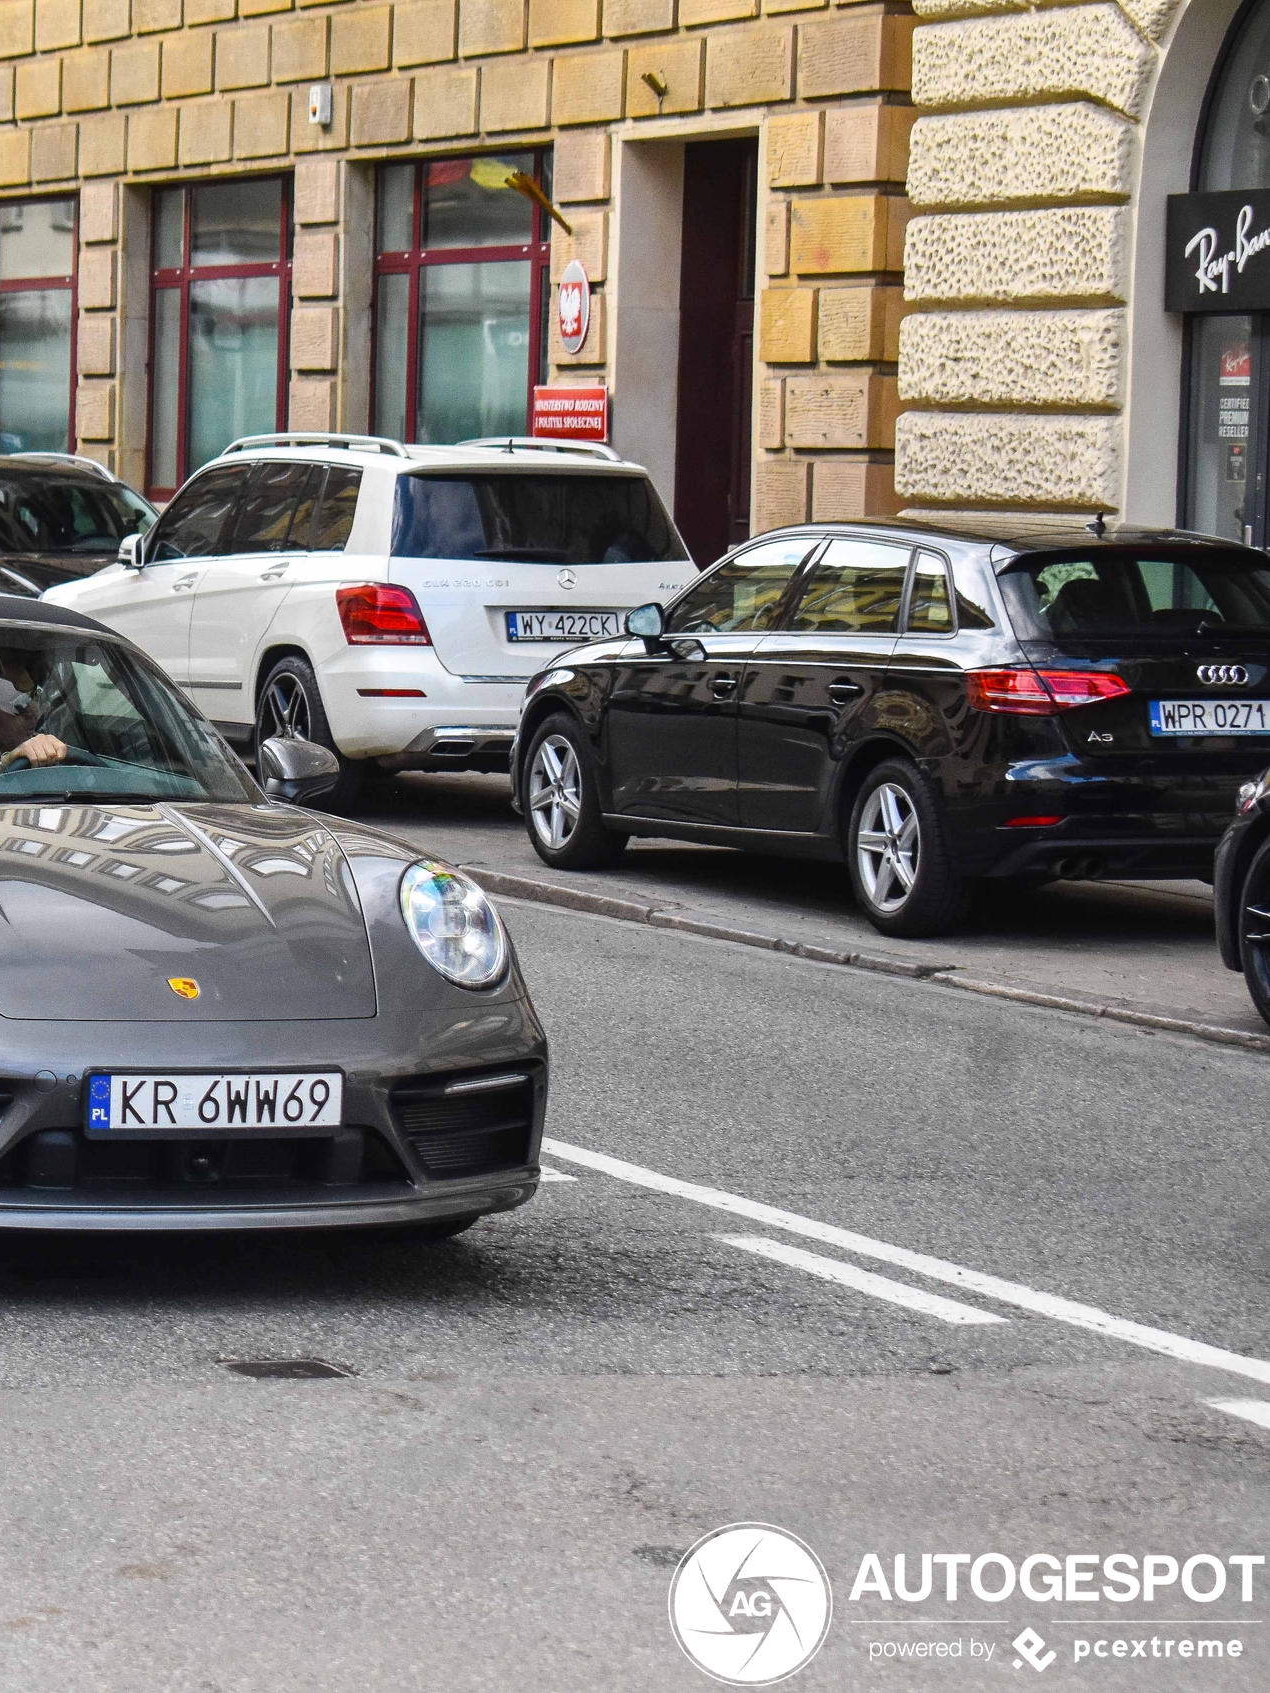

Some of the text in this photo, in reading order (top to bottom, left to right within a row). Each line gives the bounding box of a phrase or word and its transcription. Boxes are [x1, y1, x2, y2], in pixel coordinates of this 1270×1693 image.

[575, 399, 605, 412] RODZINY
[423, 579, 510, 588] GLK 220 CDI
[521, 615, 612, 636] WY 422CK
[1162, 704, 1207, 729] WPR
[1087, 730, 1114, 742] A3
[120, 1078, 330, 1124] KR 6WW69
[91, 1108, 108, 1121] PL
